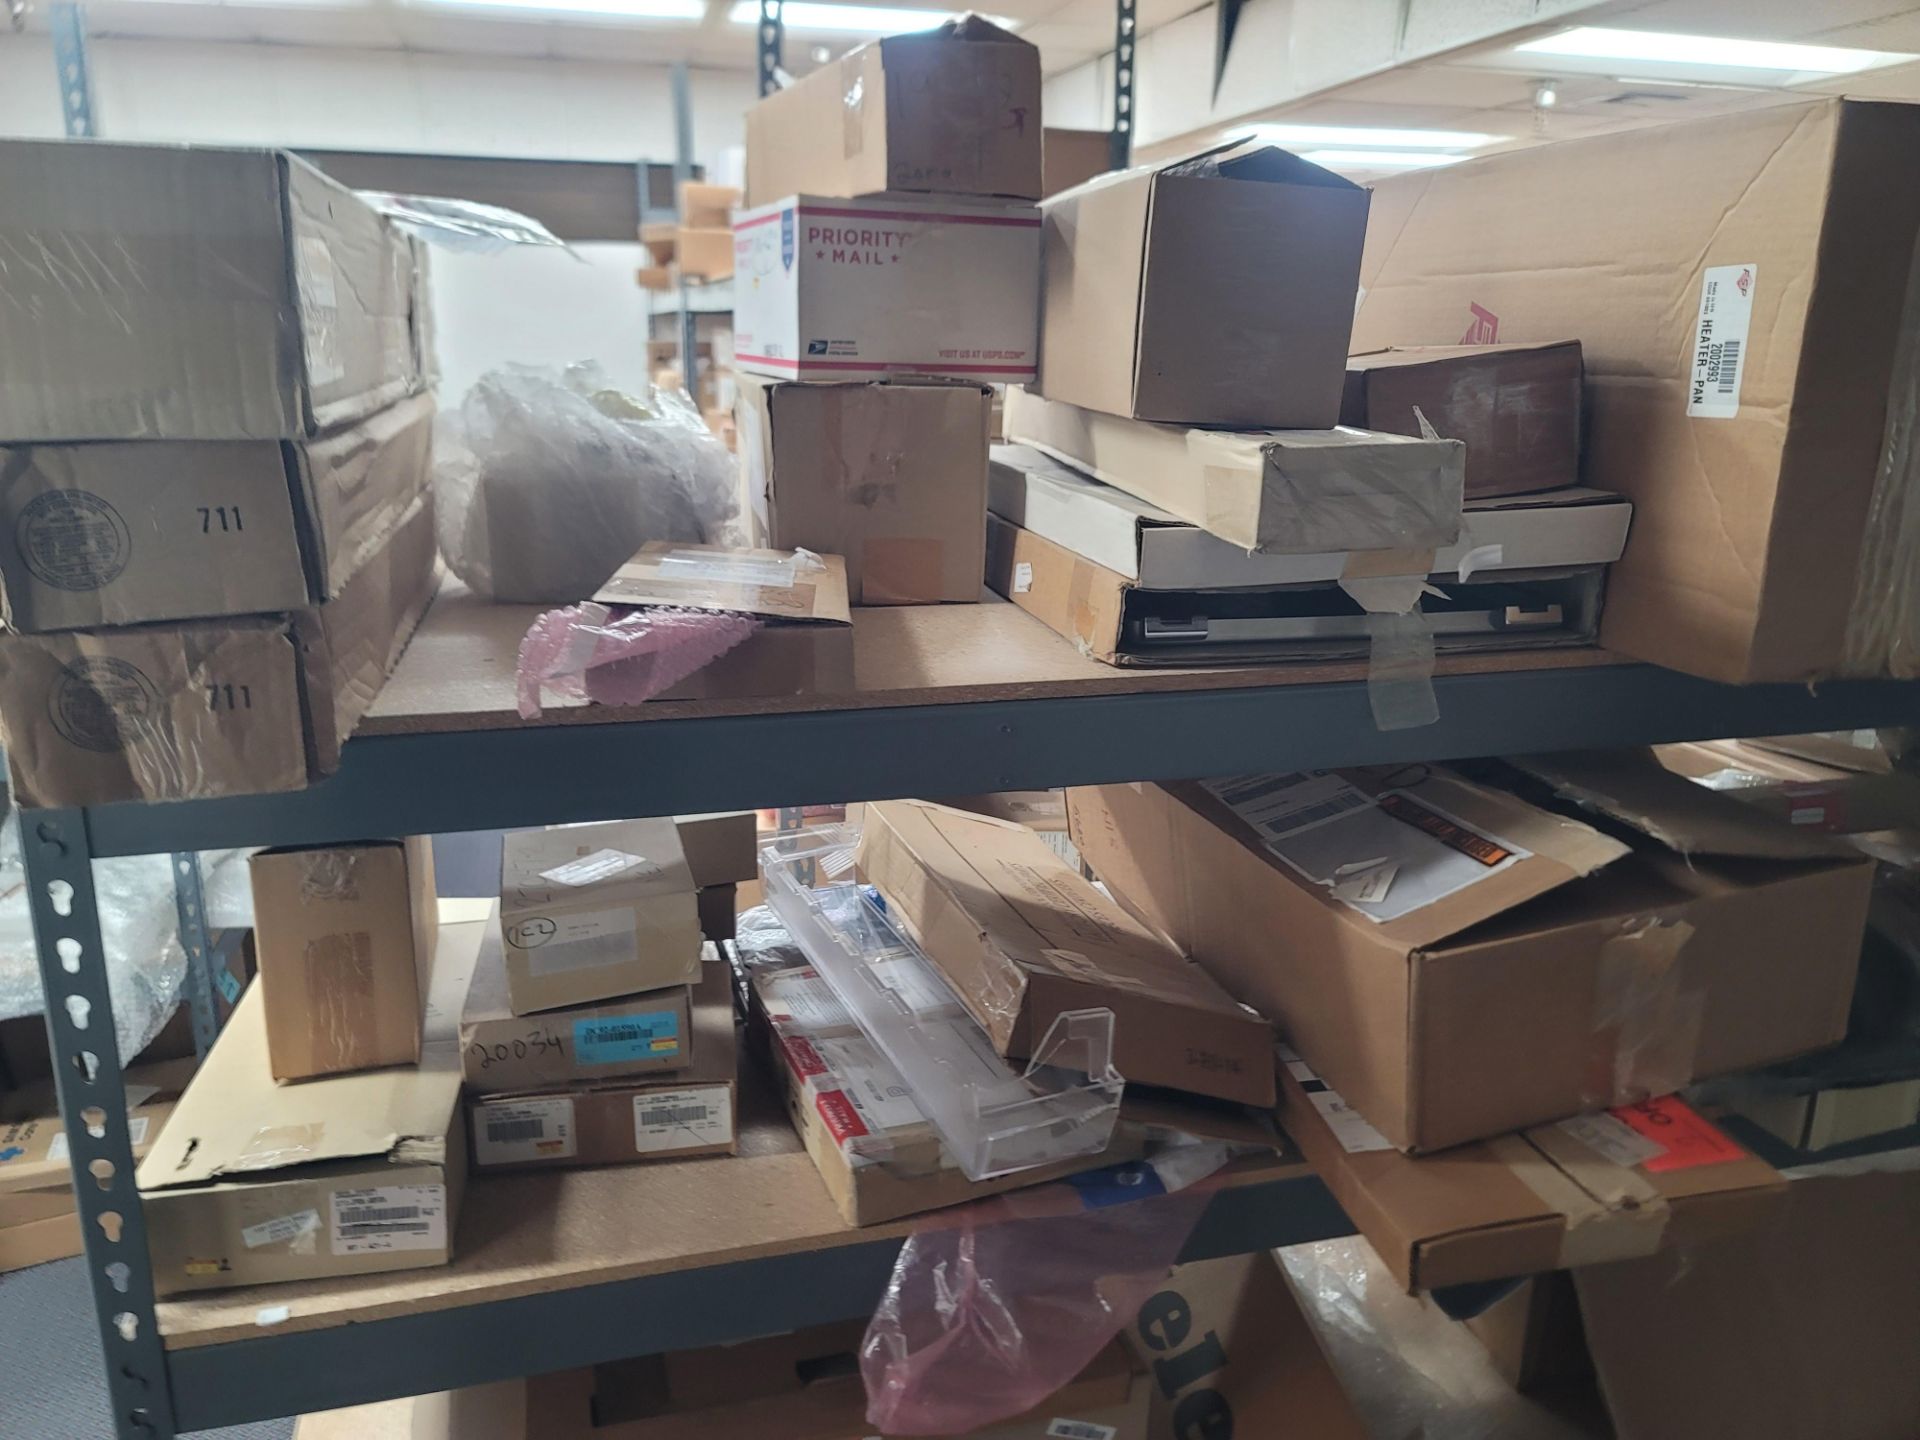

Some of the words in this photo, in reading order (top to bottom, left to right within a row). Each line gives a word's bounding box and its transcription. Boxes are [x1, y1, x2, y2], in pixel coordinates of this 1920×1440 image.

[808, 227, 908, 247] PRIORITY
[832, 250, 883, 265] MAIL
[1740, 268, 1750, 297] FSP
[1697, 319, 1713, 367] HEATER
[1706, 343, 1723, 383] 2002993
[1693, 380, 1705, 404] PAN
[196, 506, 243, 533] 711
[206, 683, 251, 711] 711
[471, 1027, 565, 1070] 20034
